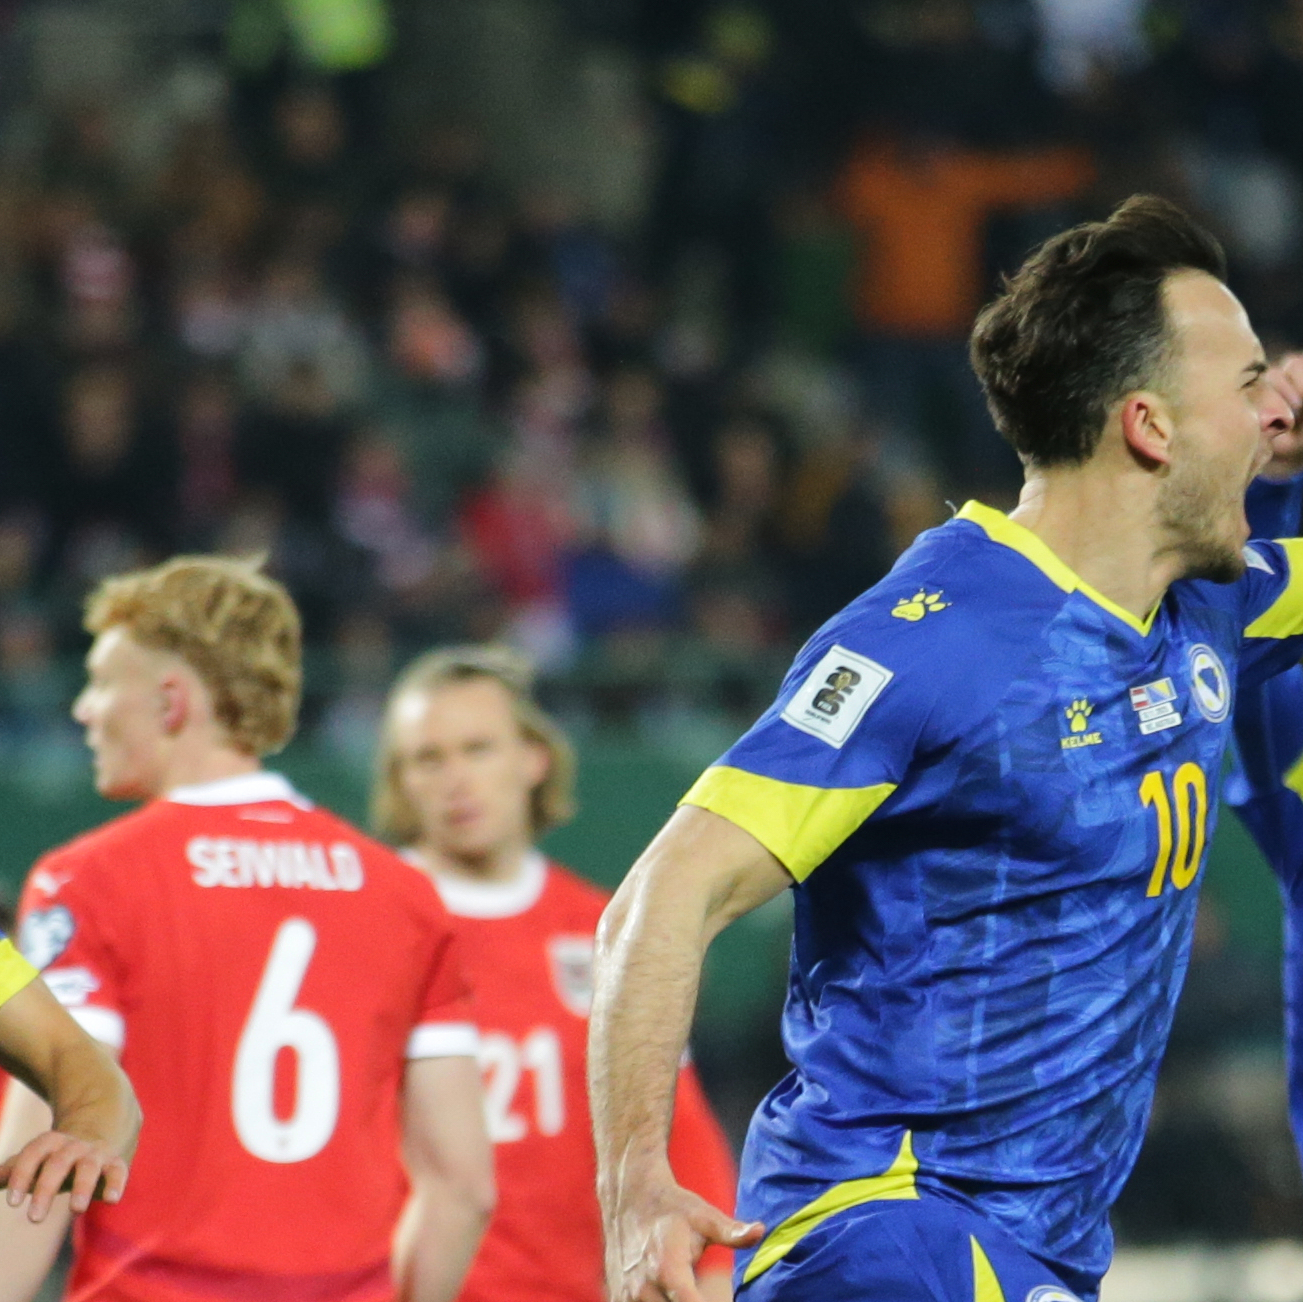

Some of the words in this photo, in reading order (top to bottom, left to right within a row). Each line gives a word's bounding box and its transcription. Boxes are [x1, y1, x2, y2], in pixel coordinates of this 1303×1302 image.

[1061, 731, 1103, 749] KELME
[1139, 762, 1208, 898] 10
[230, 916, 341, 1165] 6
[478, 1027, 564, 1142] 21
